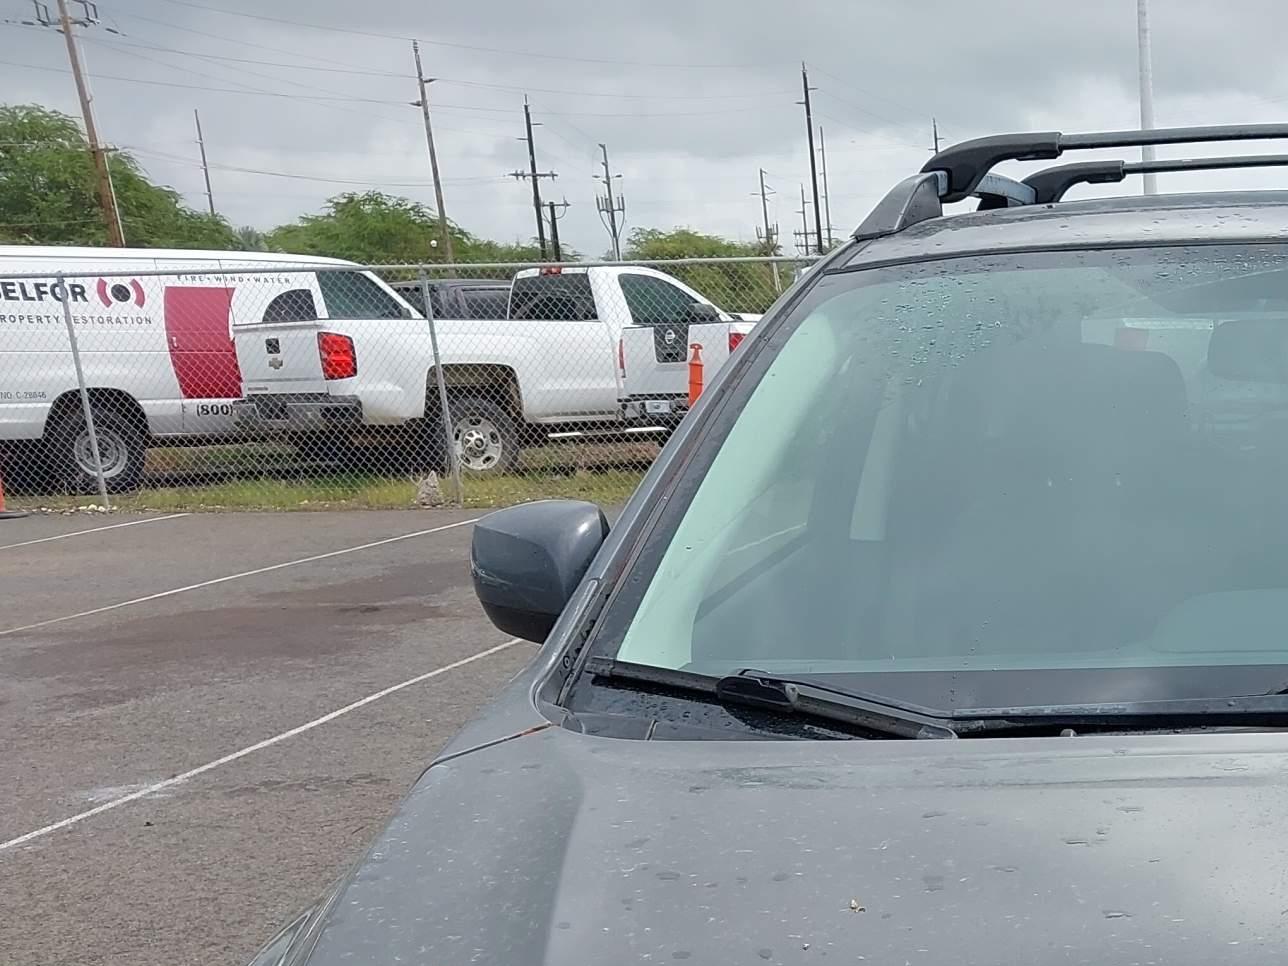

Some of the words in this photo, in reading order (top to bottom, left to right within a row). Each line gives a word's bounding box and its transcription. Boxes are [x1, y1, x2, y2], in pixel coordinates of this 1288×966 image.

[0, 281, 88, 303] ELFOR
[0, 314, 59, 324] ROPERTY
[73, 315, 152, 325] ESTORATION
